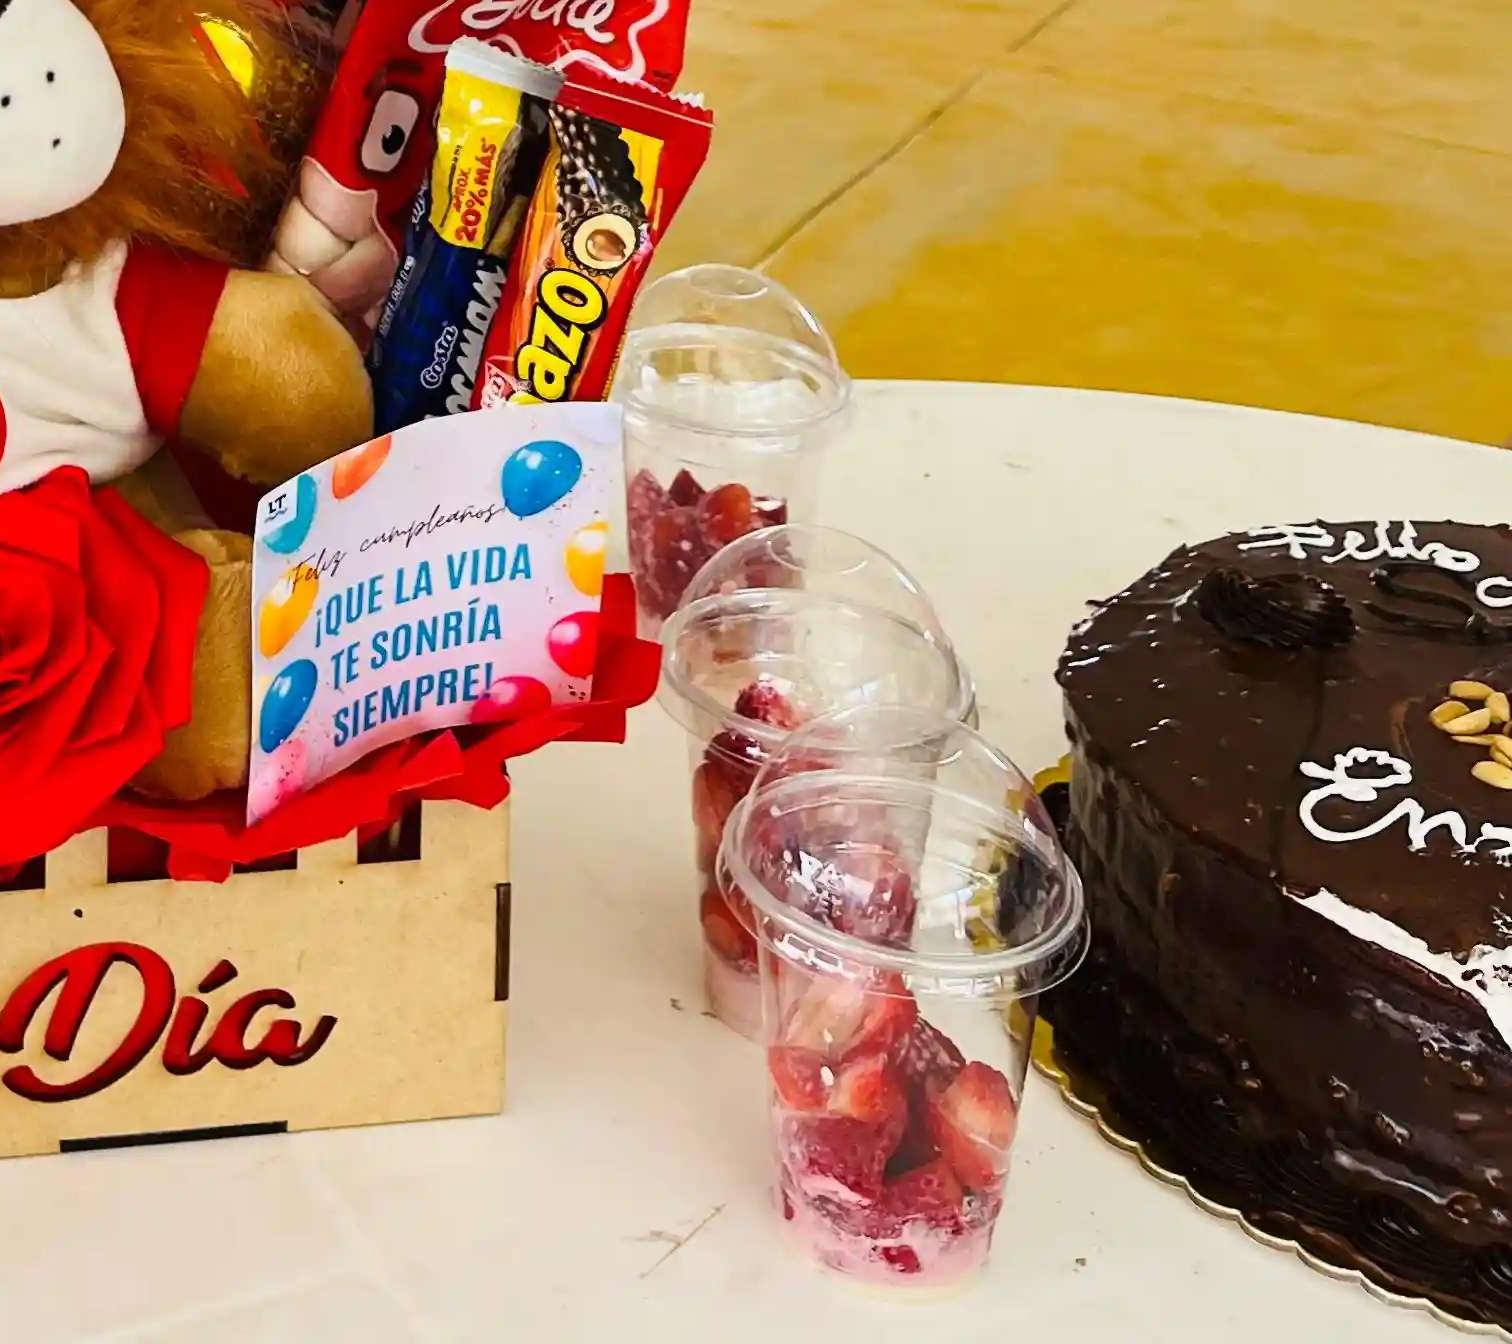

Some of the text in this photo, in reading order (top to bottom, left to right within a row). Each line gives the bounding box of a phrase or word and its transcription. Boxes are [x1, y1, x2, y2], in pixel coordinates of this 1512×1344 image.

[455, 188, 488, 242] 20%
[420, 324, 459, 389] Costa
[268, 493, 287, 514] LT
[292, 503, 506, 594] Feliz cumpleaños
[315, 543, 532, 648] ¡QUE LA VIDA
[330, 597, 502, 690] TE SONRÍA
[331, 661, 496, 749] SIEMPRE!
